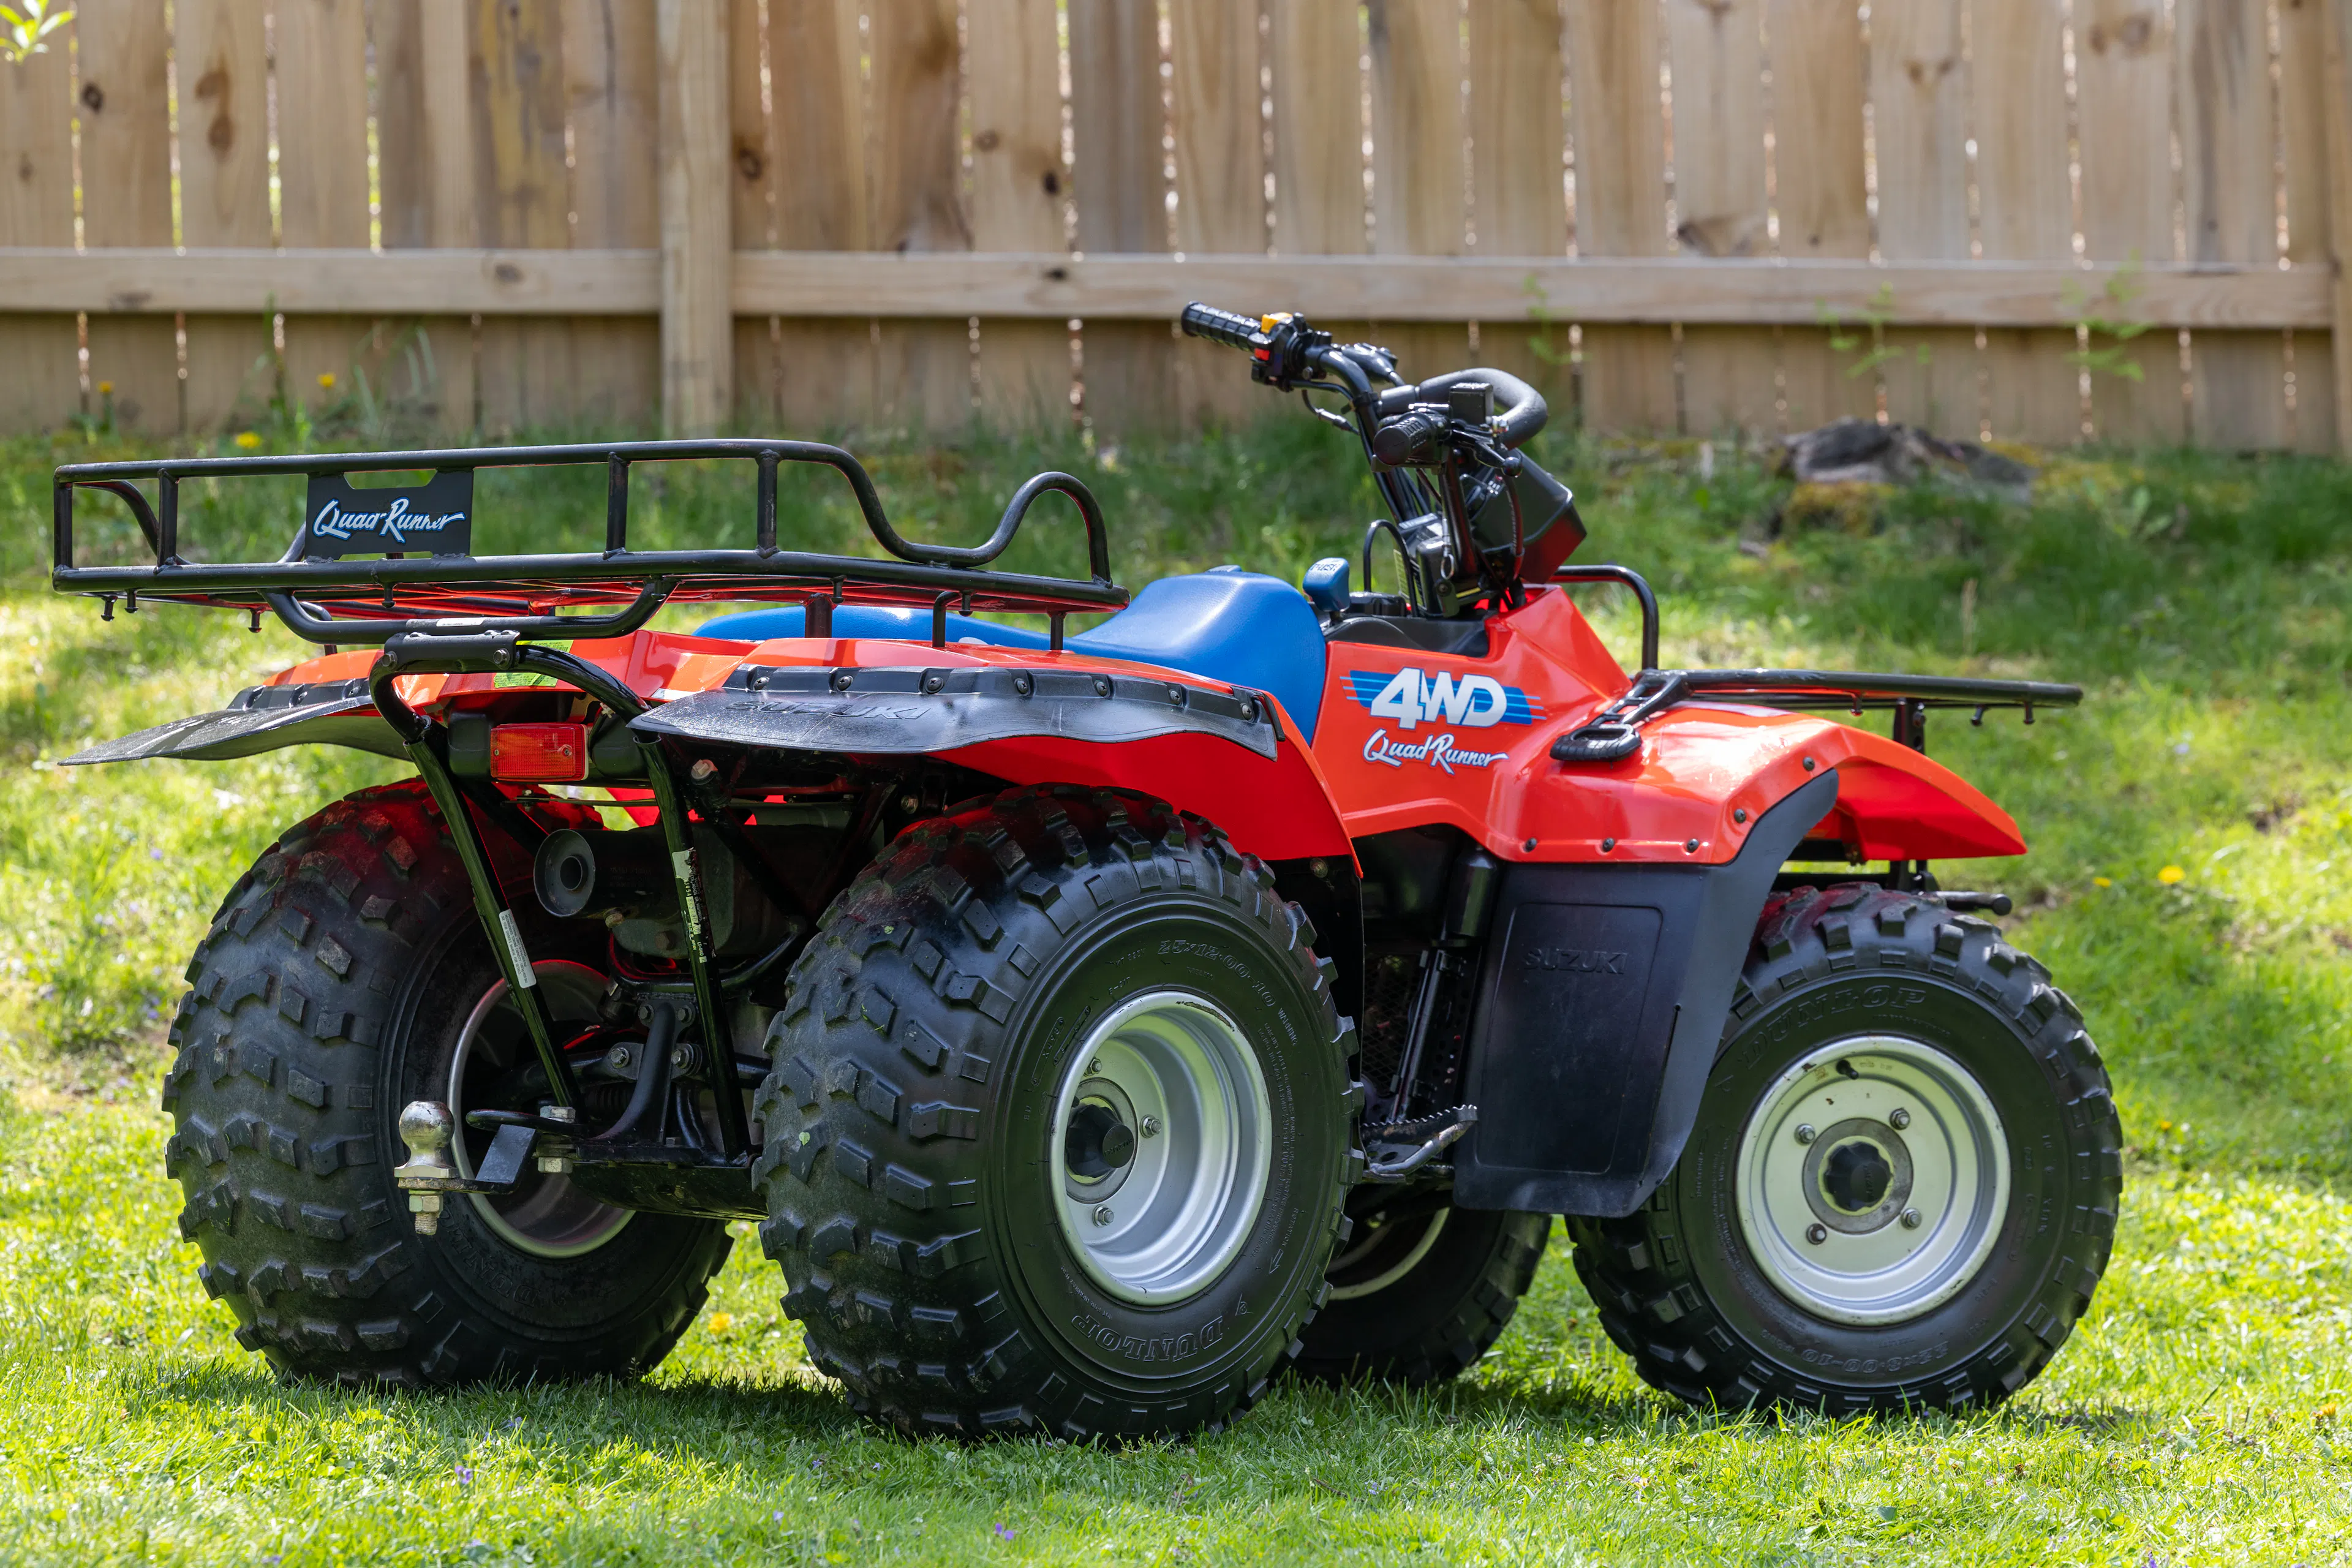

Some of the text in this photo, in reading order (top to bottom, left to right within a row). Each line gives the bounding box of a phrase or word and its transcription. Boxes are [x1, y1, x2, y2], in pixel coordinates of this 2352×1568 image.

[725, 700, 932, 720] SUZUKI
[1370, 666, 1507, 729] 4WD
[1524, 948, 1627, 974] SUZUKI
[1276, 1006, 1299, 1047] WARNING
[1741, 985, 1926, 1069] DUNLOP
[1280, 1205, 1299, 1250] ROTATION
[1071, 1314, 1223, 1363] DUNLOP
